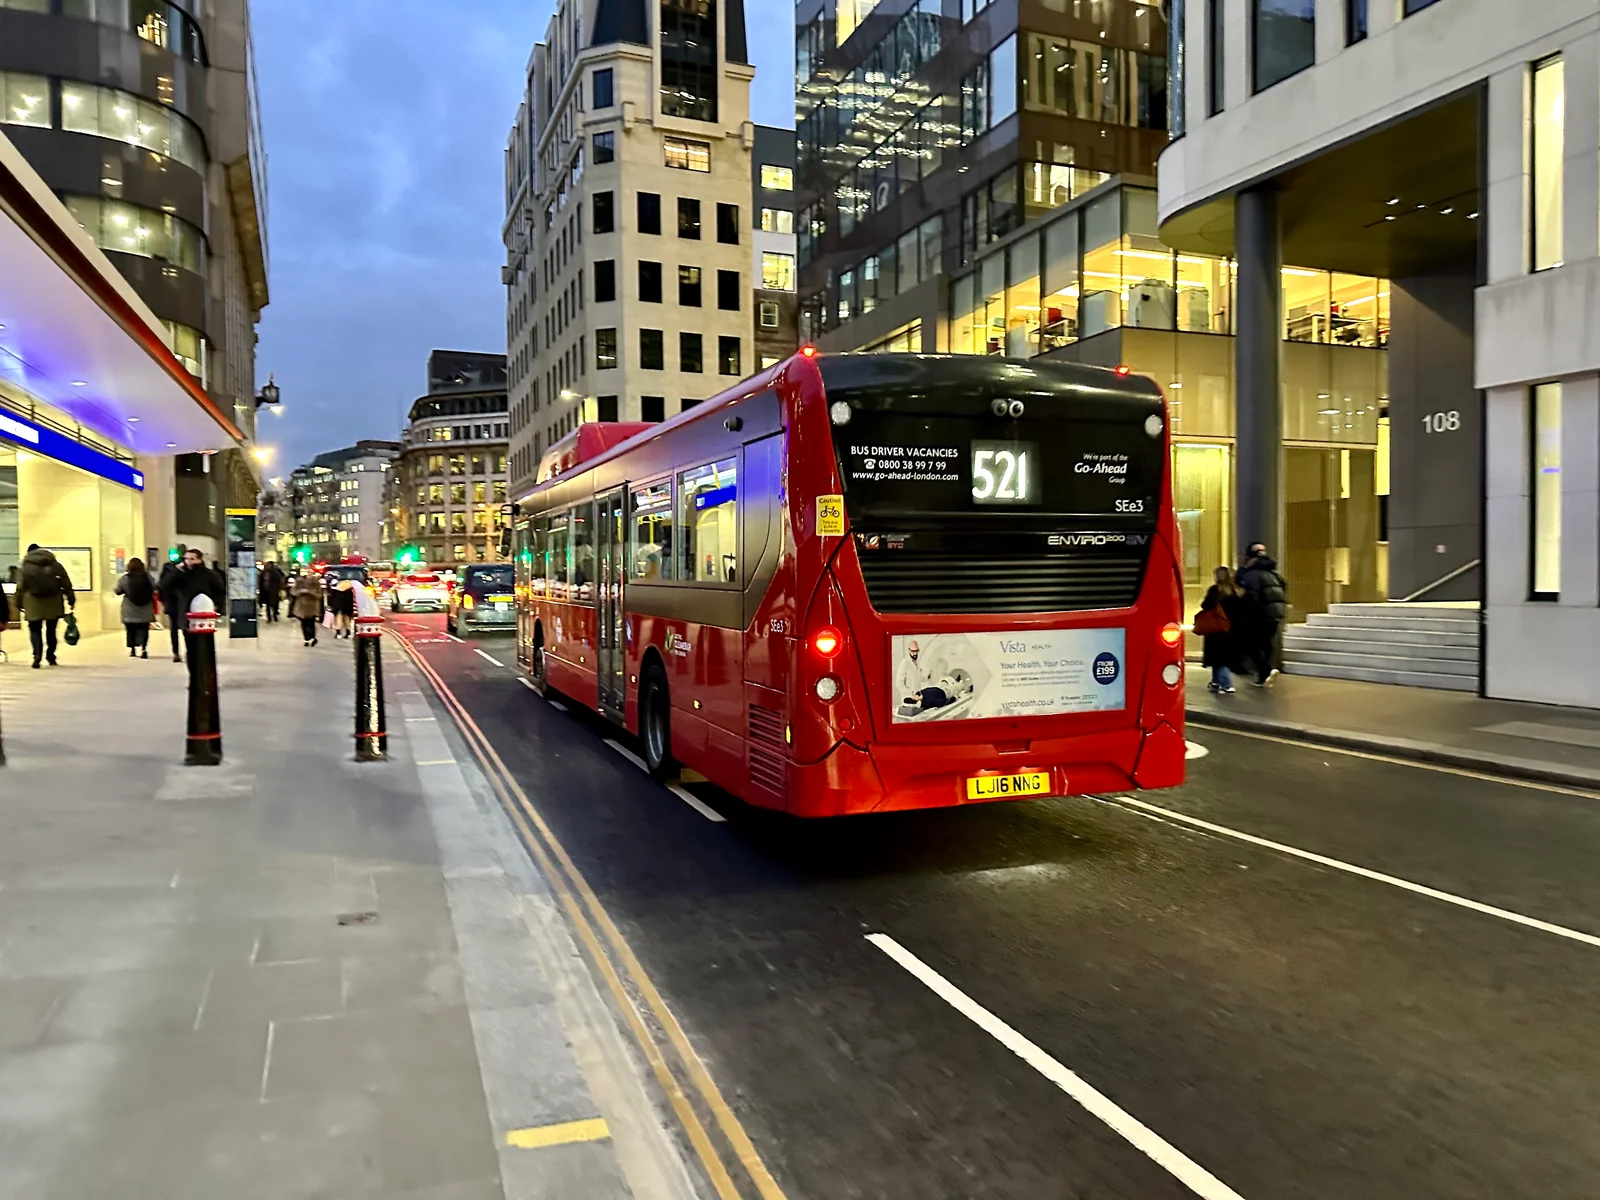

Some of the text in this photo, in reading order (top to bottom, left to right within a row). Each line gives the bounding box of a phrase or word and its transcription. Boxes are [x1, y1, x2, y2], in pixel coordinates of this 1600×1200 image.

[1421, 410, 1460, 434] 108
[851, 445, 959, 458] BUS DRIVER VACANCIES
[1099, 454, 1112, 462] part
[1112, 453, 1120, 462] of
[878, 459, 947, 470] 0800 38 99 7 99
[1074, 462, 1128, 474] Go-Ahead
[852, 471, 959, 481] www.go-ahead-london.com
[972, 450, 1026, 499] 521
[1108, 476, 1126, 485] Group
[1115, 499, 1144, 512] SEe3
[770, 619, 784, 633] SEe3
[1000, 640, 1026, 653] Vista
[1000, 662, 1016, 670] Your
[1043, 660, 1059, 668] Your
[1096, 666, 1115, 675] £199
[1001, 698, 1054, 709] vistahealth.co.uk
[976, 775, 1041, 795] LJ16 NNG
